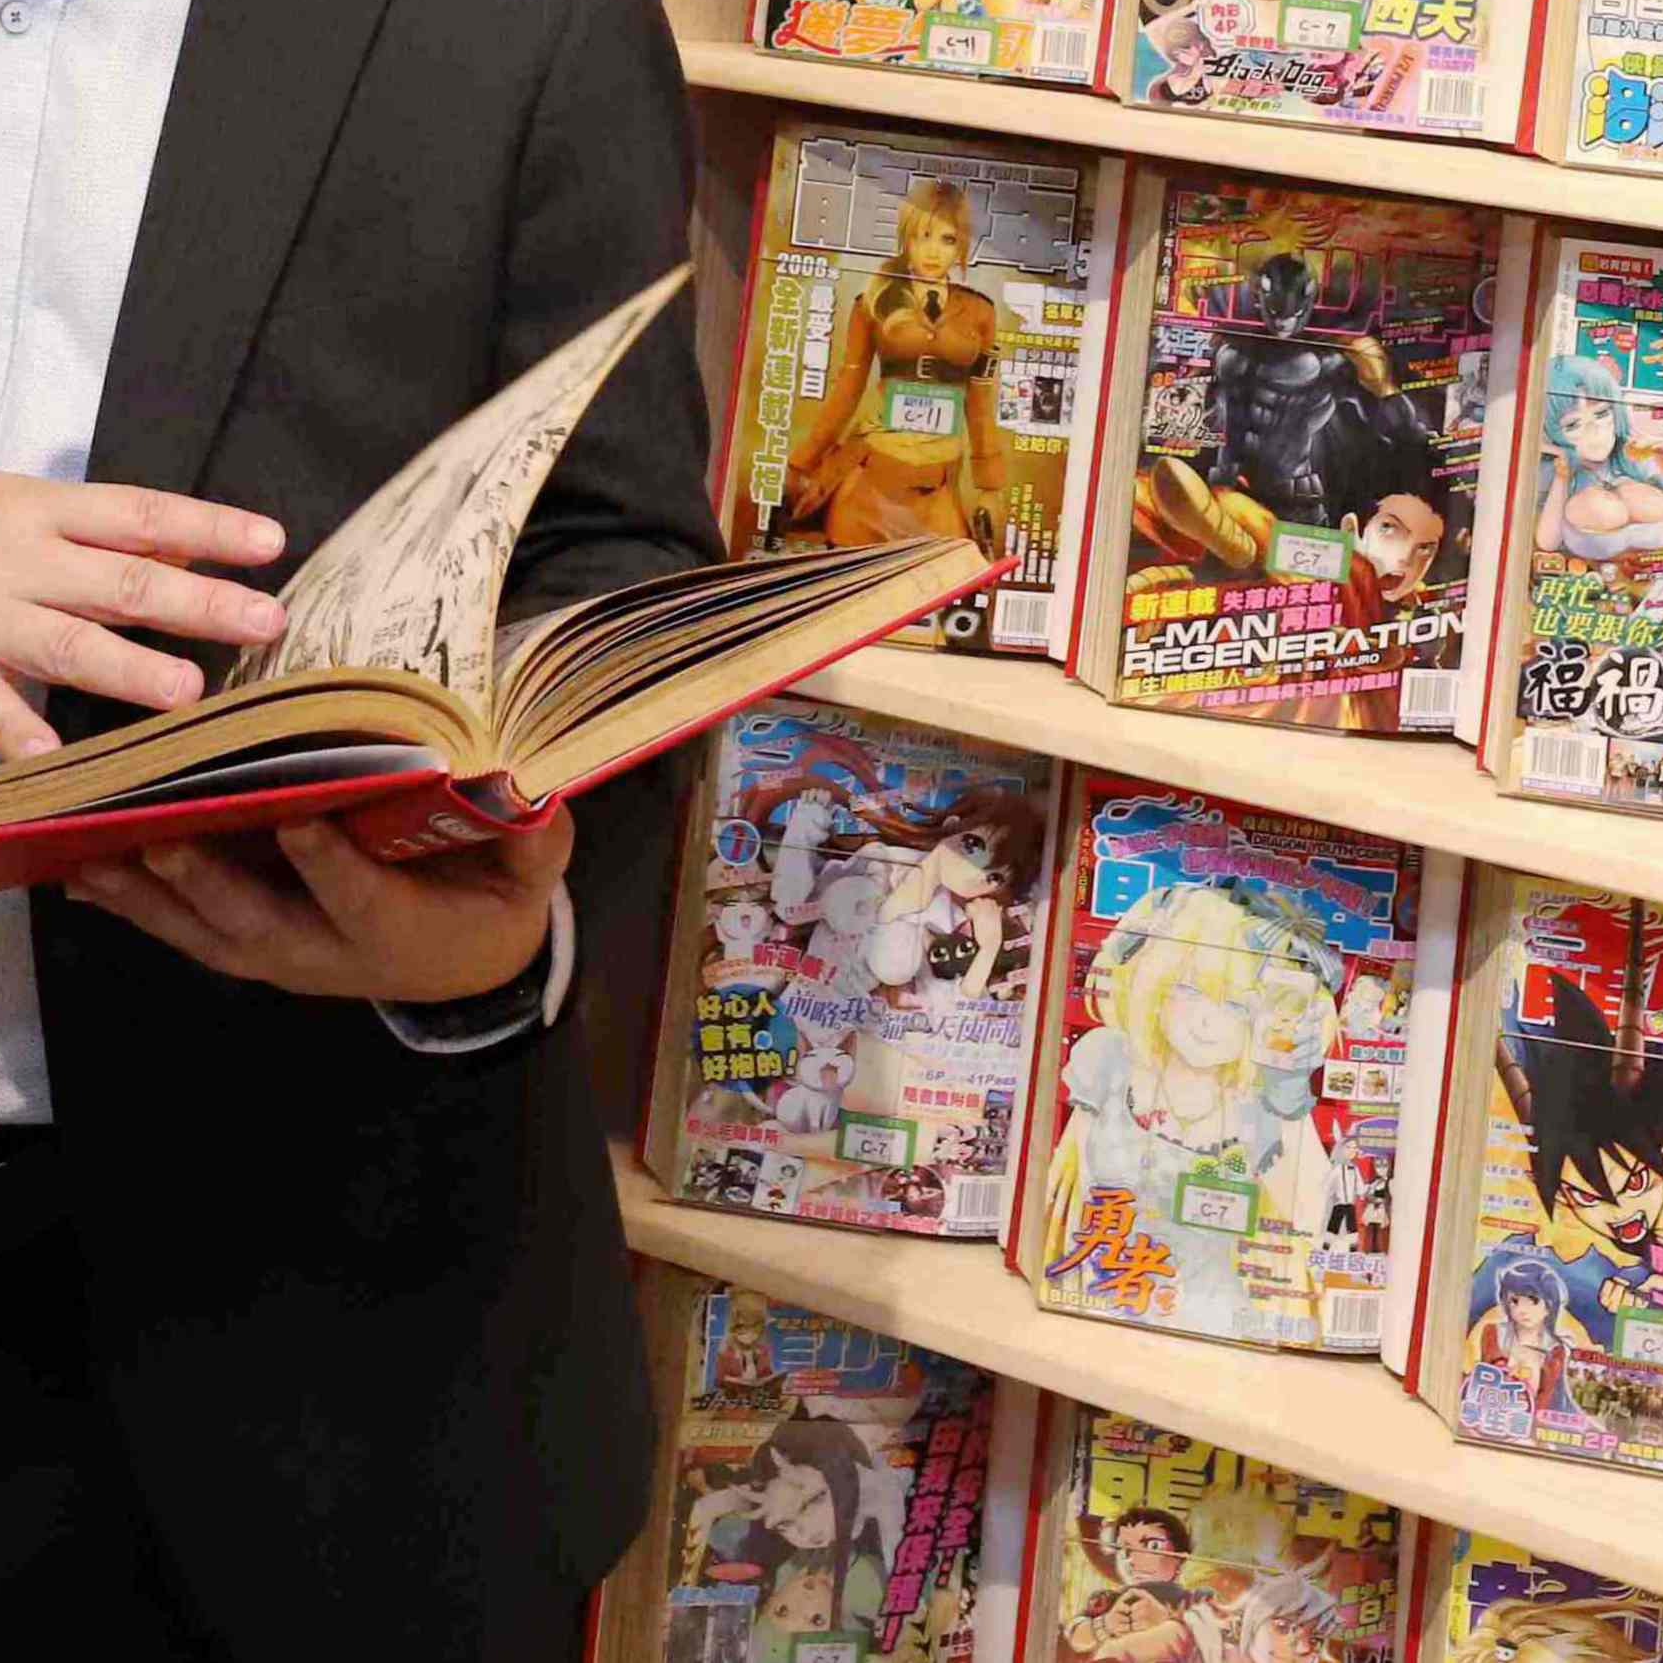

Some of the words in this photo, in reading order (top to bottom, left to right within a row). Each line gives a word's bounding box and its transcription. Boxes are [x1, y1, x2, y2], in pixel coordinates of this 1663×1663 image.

[1122, 609, 1467, 677] REGENERATION
[1123, 612, 1277, 652] L-MAN
[860, 1139, 888, 1156] C-7
[1199, 1202, 1229, 1220] C-7
[1043, 1185, 1181, 1316] 勇者
